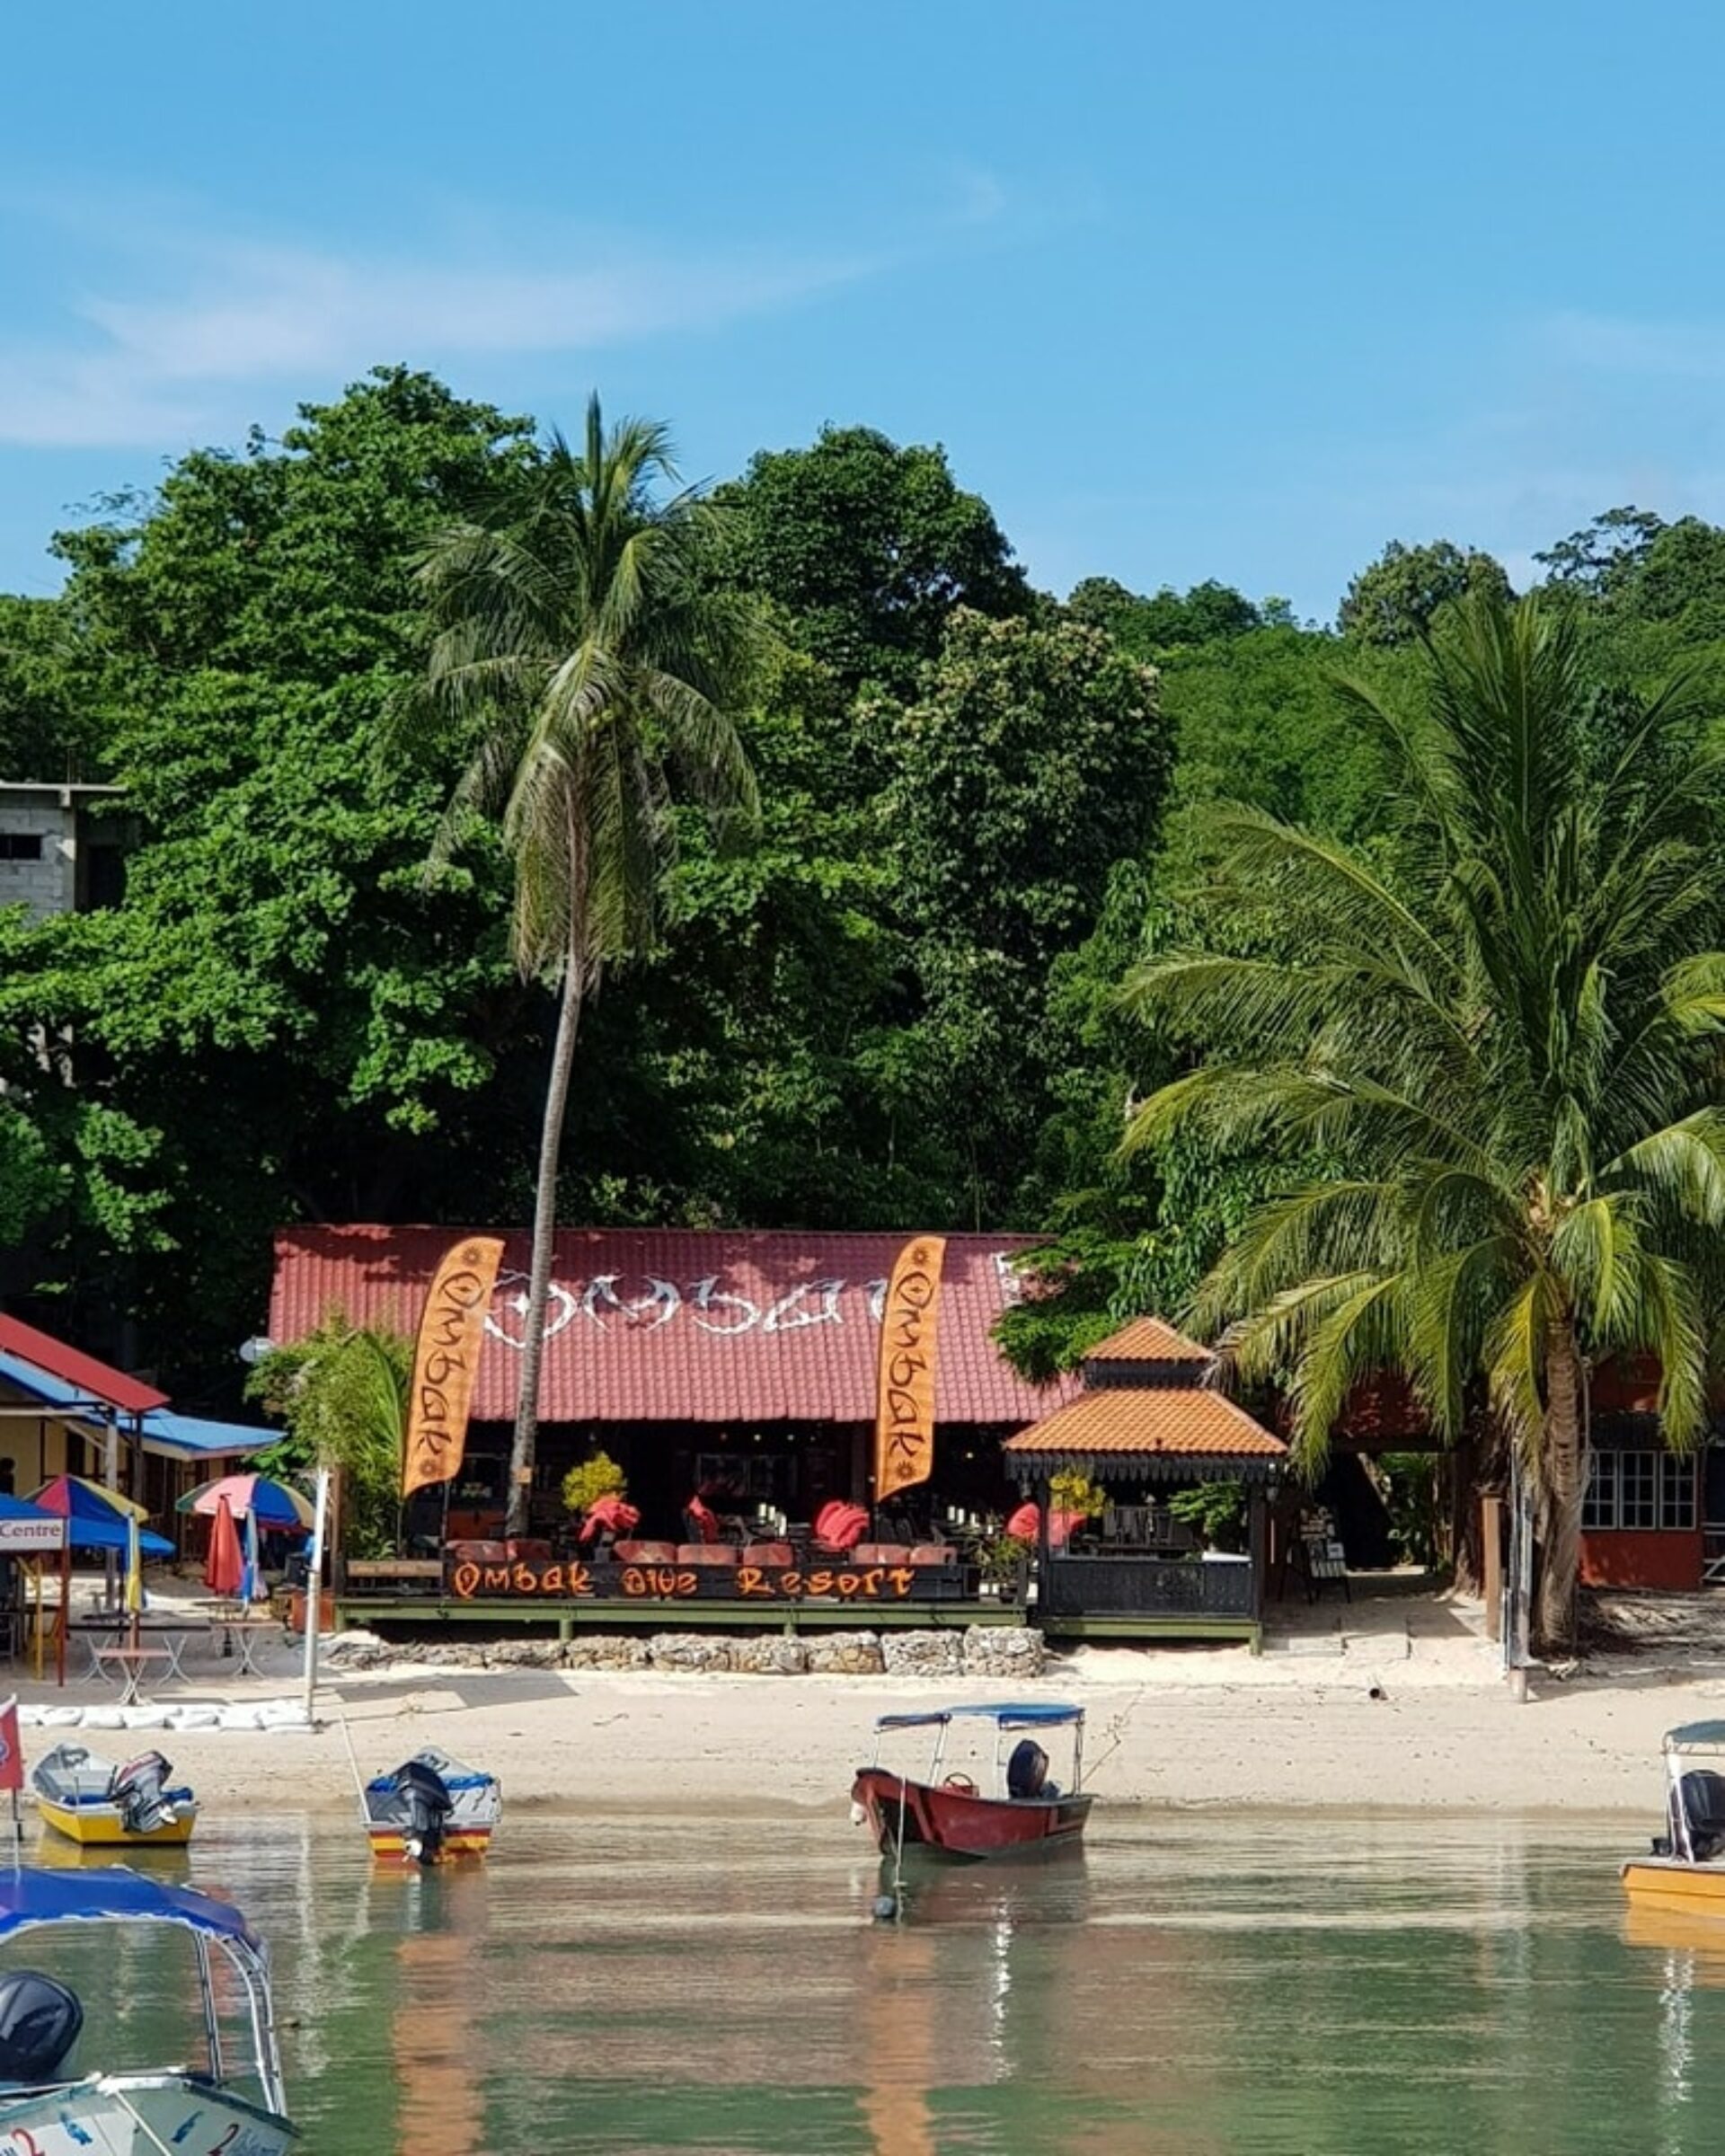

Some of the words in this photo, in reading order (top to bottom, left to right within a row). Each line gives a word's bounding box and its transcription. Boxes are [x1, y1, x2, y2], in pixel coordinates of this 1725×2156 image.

[0, 1522, 61, 1537] Centre
[455, 1561, 596, 1598] Ombak
[738, 1567, 916, 1596] Resort
